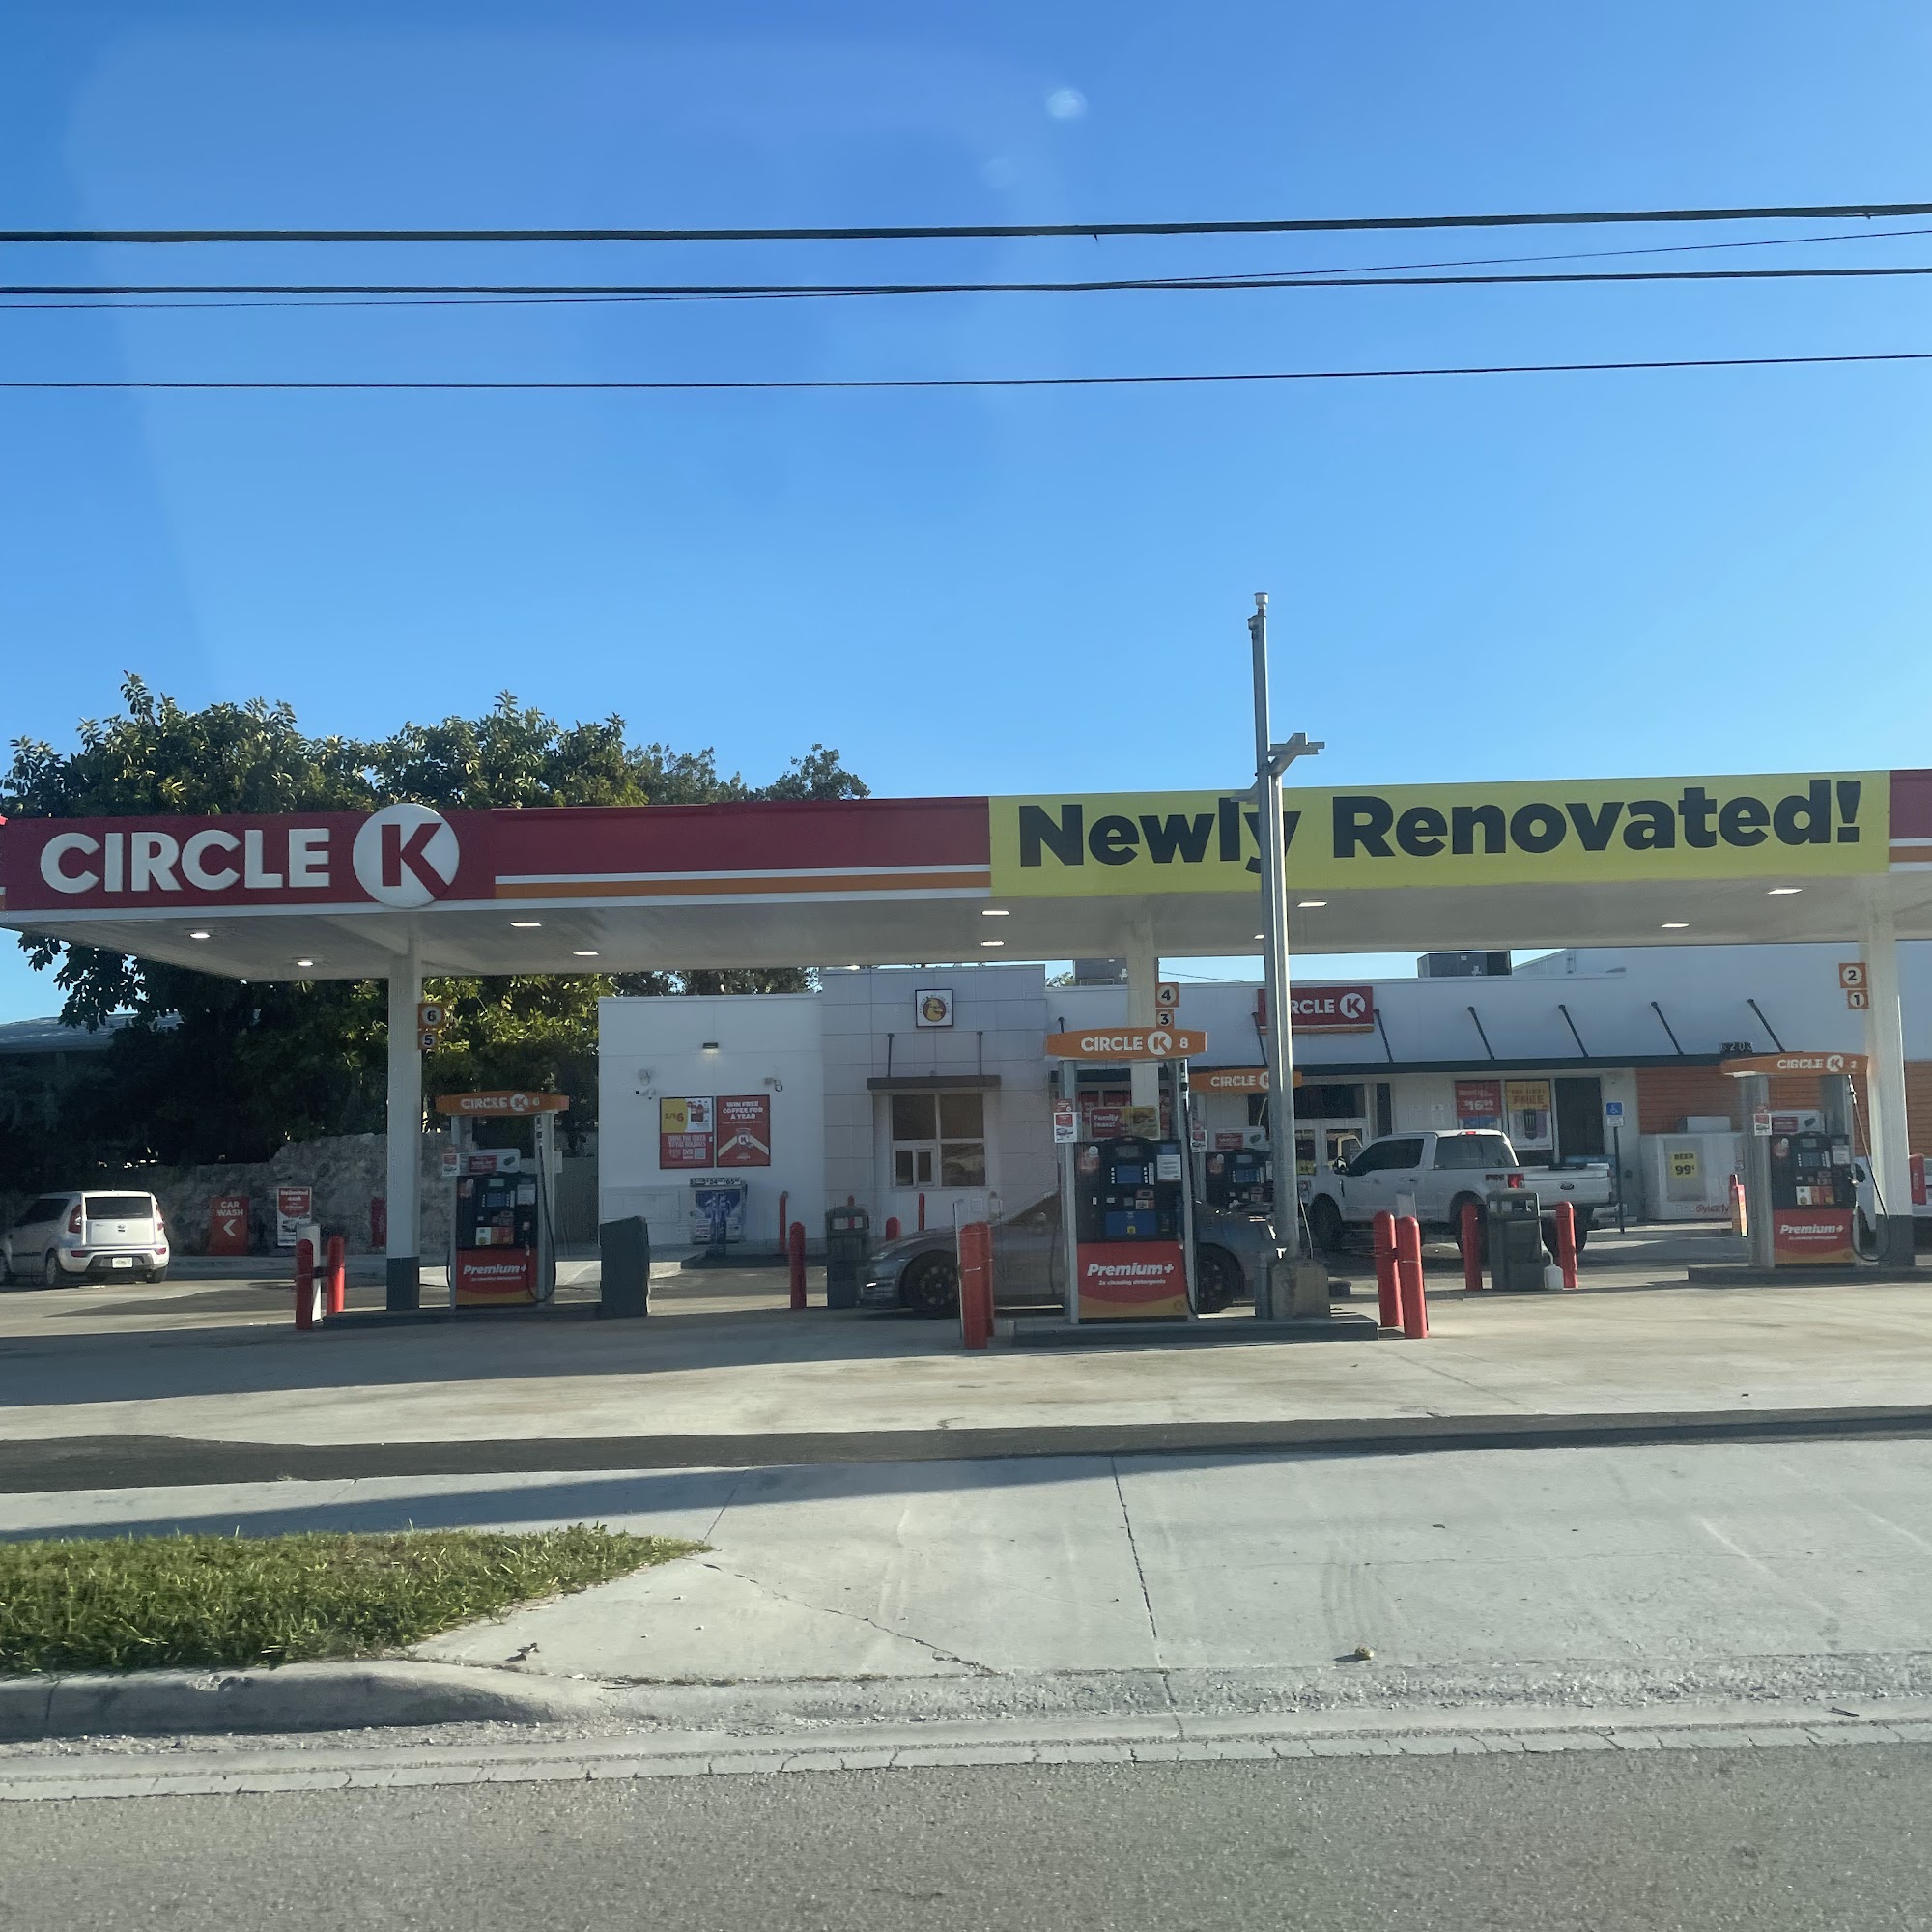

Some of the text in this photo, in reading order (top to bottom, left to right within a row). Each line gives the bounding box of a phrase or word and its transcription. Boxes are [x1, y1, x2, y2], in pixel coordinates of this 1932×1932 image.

[1019, 779, 1861, 874] Newly Renovated!
[40, 820, 451, 901] CIRCLE K
[1848, 970, 1858, 980] 2
[1161, 989, 1171, 1001] 4
[1853, 994, 1861, 1006] 1
[1291, 996, 1365, 1017] RCLE K
[426, 1010, 437, 1022] 6
[1160, 1013, 1169, 1025] 3
[424, 1034, 433, 1045] 5
[1080, 1034, 1189, 1055] CIRCLE K 8
[1777, 1059, 1825, 1069] CIRCLE
[1210, 1075, 1256, 1088] CIRCLE
[461, 1097, 508, 1109] CIRCLE
[1779, 1224, 1844, 1235] Premium+
[463, 1264, 527, 1275] Premium+
[1087, 1262, 1175, 1277] Premium+
